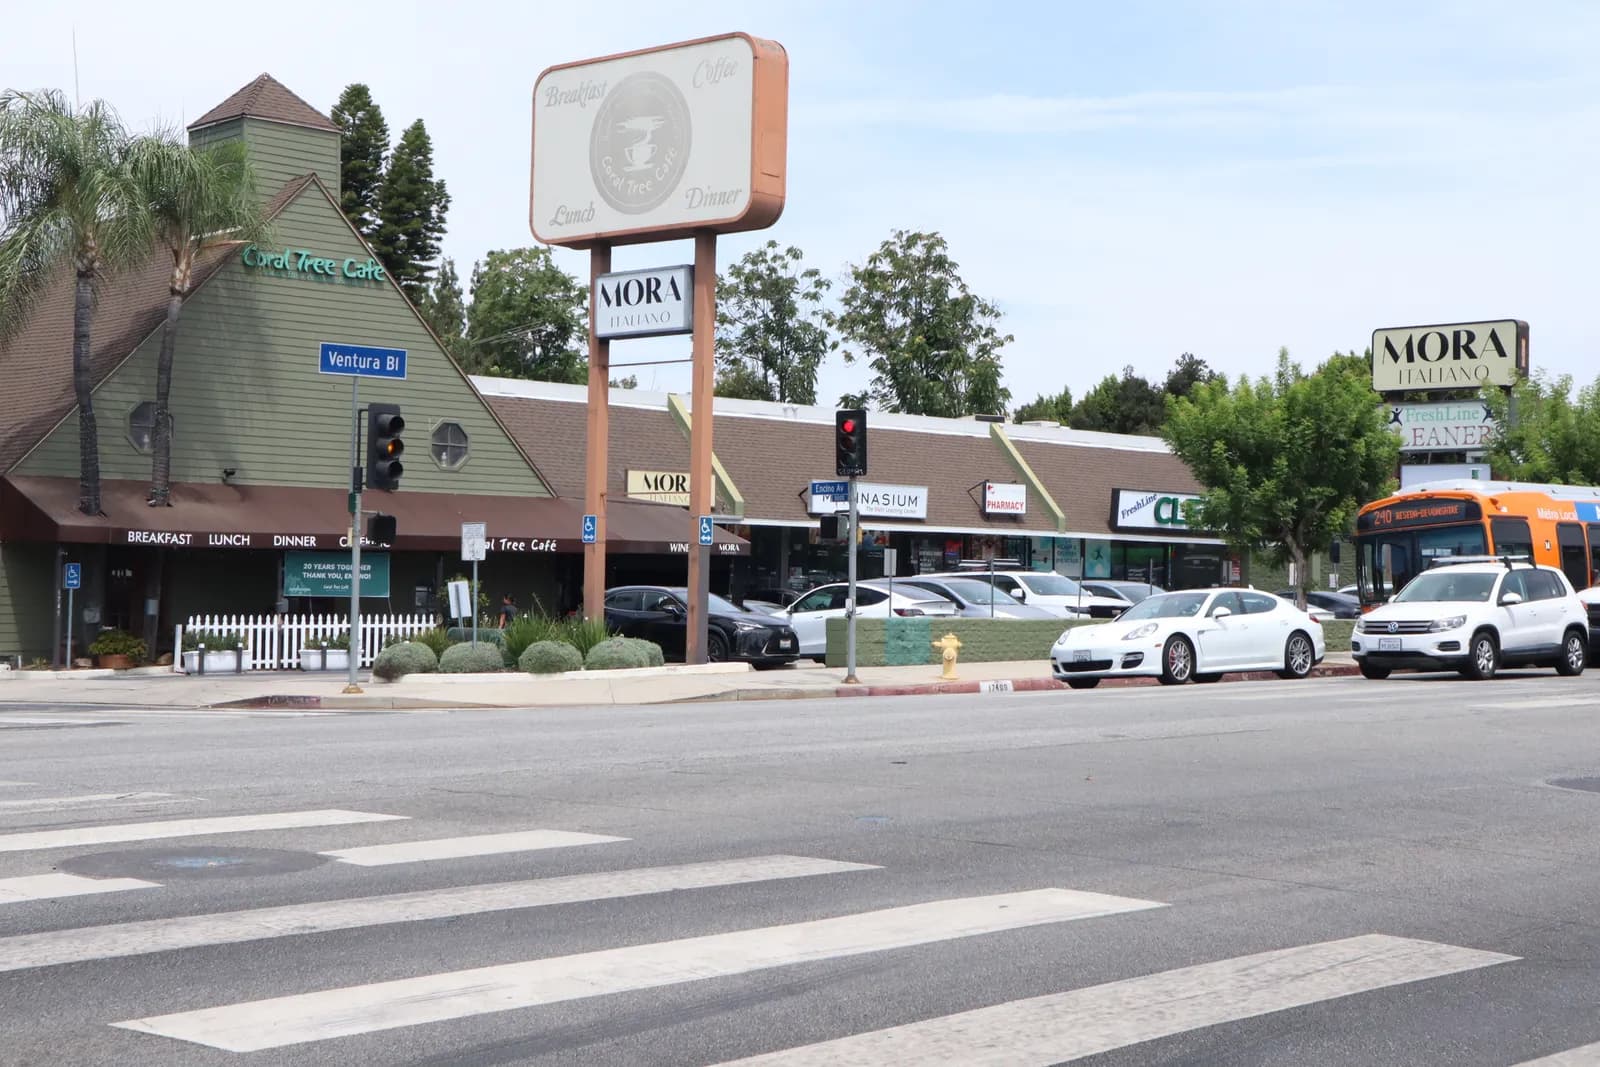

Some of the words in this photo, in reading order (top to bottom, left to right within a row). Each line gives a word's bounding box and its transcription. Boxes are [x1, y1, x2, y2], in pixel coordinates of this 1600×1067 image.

[692, 56, 738, 88] Coffee
[544, 79, 608, 108] Breakfast
[601, 156, 625, 191] Coral
[627, 181, 652, 195] Tree
[685, 185, 742, 210] Dinner
[549, 201, 595, 227] Lunch
[243, 243, 291, 270] Coral
[295, 250, 337, 276] Tree
[600, 274, 682, 309] MORA
[610, 311, 671, 328] ITALIANO
[1382, 327, 1508, 365] MORA
[328, 351, 380, 370] Ventura
[386, 356, 399, 371] Bl
[1399, 365, 1490, 385] ITALIANO
[1405, 404, 1481, 423] FreshLine
[642, 473, 687, 492] MOR
[815, 484, 835, 493] Encino
[836, 485, 844, 493] Av
[987, 500, 1024, 511] PHARMACY
[1121, 493, 1158, 519] FreshLine
[1374, 509, 1393, 526] 240
[128, 531, 192, 545] BREAKFAST
[209, 534, 250, 546] LUNCH
[273, 535, 317, 547] DINNER
[499, 538, 526, 551] Tree
[531, 539, 557, 552] Café
[719, 543, 740, 552] MORA
[328, 572, 343, 580] YOU,
